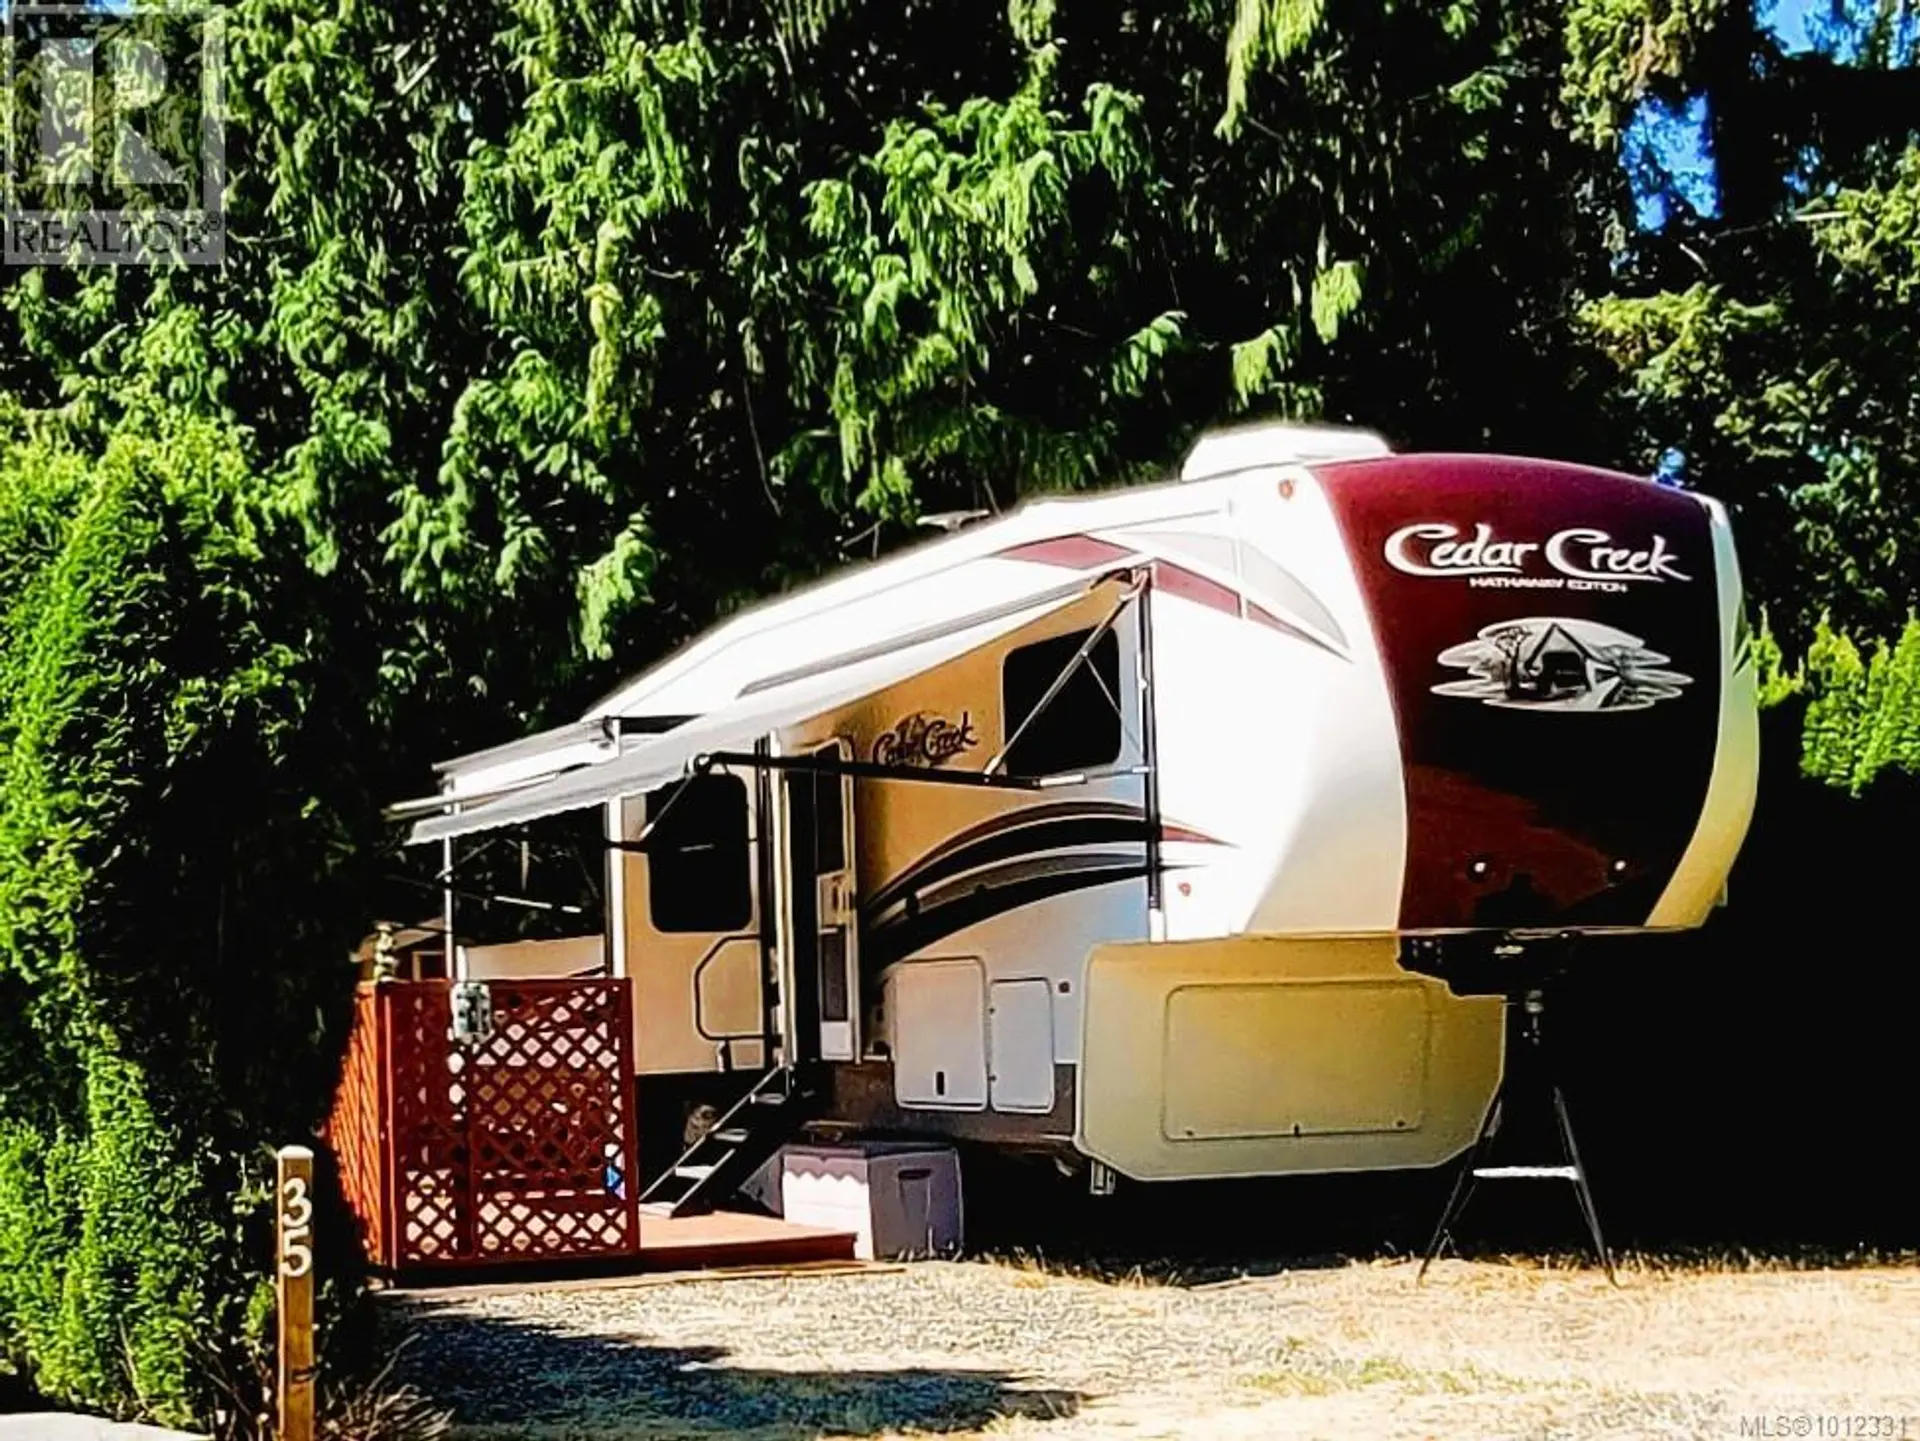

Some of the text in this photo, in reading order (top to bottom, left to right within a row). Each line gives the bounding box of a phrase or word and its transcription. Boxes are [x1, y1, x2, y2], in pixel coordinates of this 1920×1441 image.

[1384, 523, 1693, 582] Cedar Creek
[280, 1177, 313, 1277] 35
